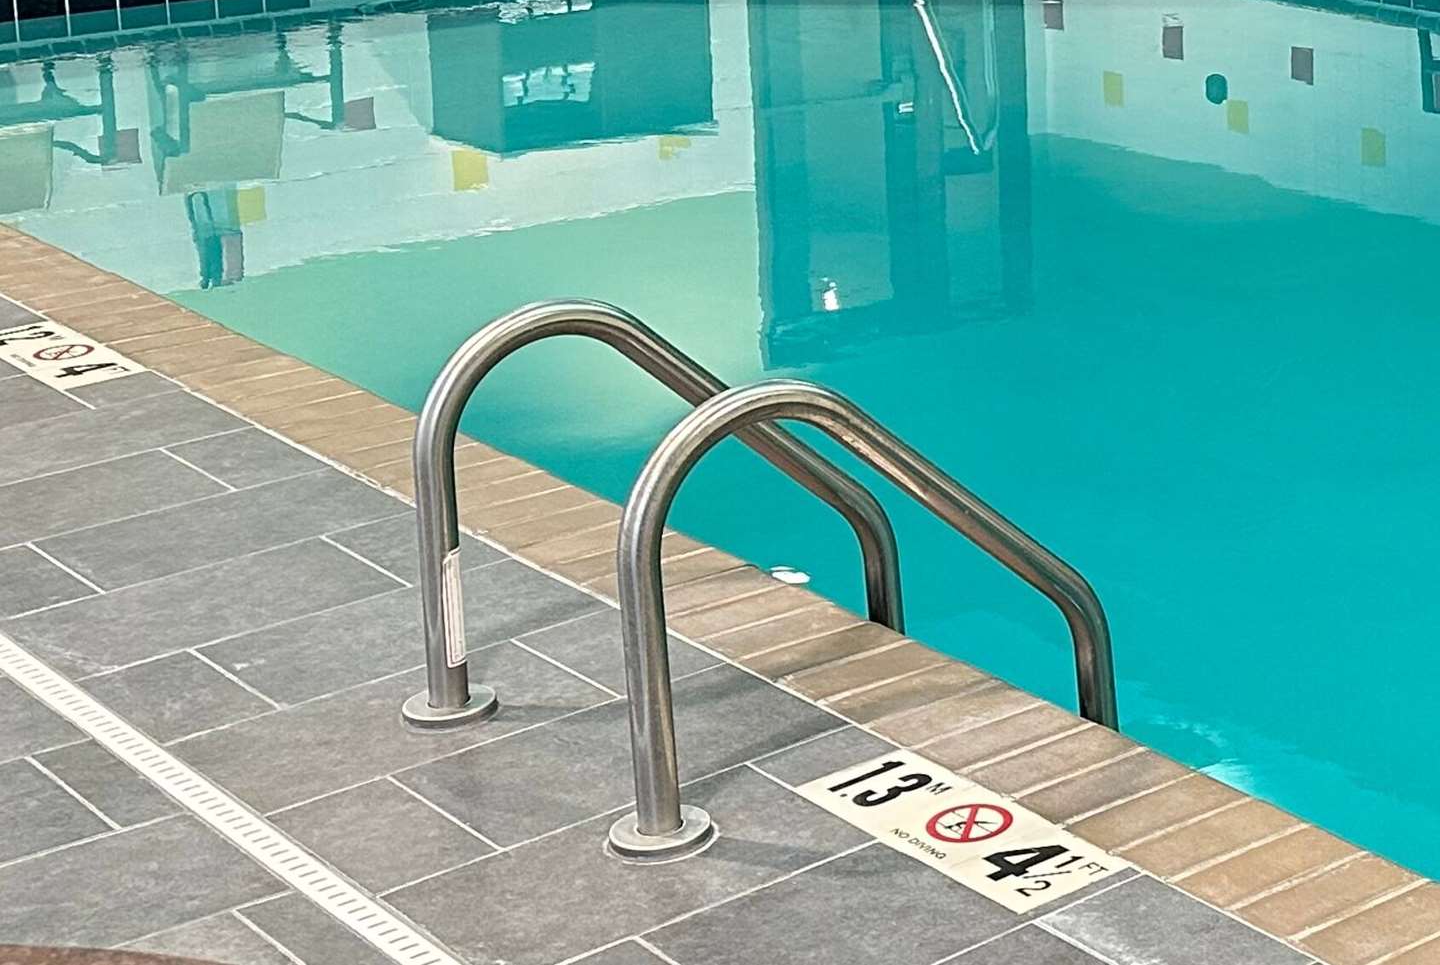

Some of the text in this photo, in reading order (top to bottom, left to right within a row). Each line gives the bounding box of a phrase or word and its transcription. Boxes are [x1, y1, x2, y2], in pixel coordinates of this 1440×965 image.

[55, 362, 118, 378] 4
[927, 780, 953, 796] M
[890, 827, 948, 860] NO DIVING
[1080, 861, 1109, 876] FT
